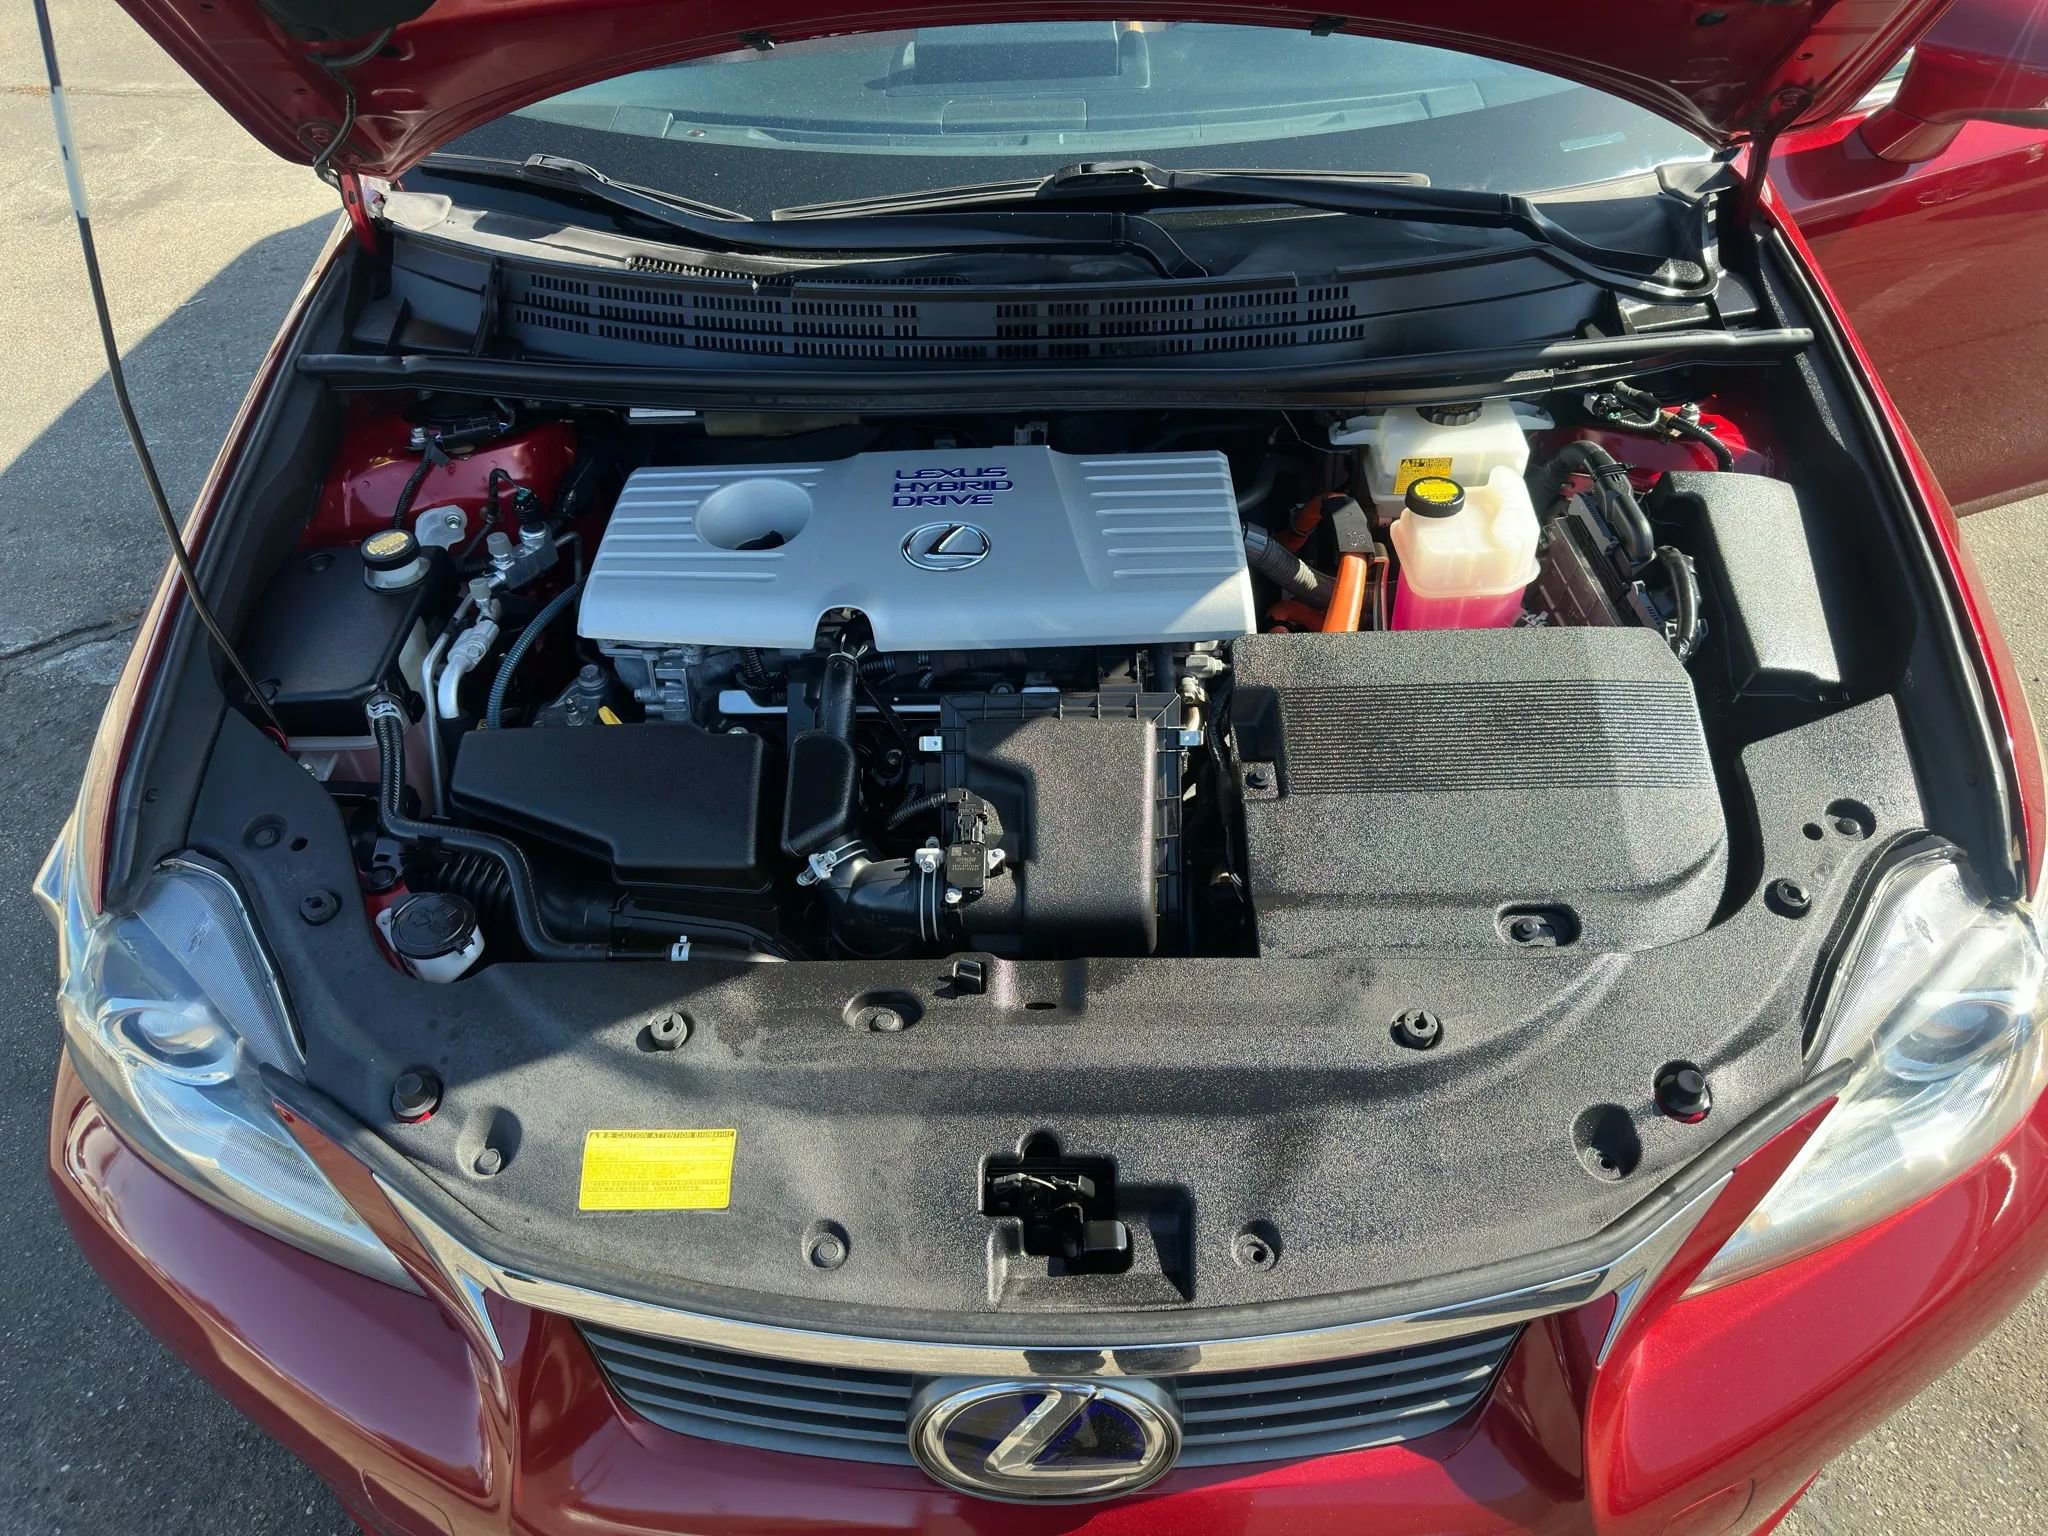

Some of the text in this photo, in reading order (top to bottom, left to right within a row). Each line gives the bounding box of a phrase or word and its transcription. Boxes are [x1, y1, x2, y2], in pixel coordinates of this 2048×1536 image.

[896, 467, 1008, 480] LEXUS
[894, 480, 1013, 494] HYBRID
[892, 494, 994, 508] DRIVE
